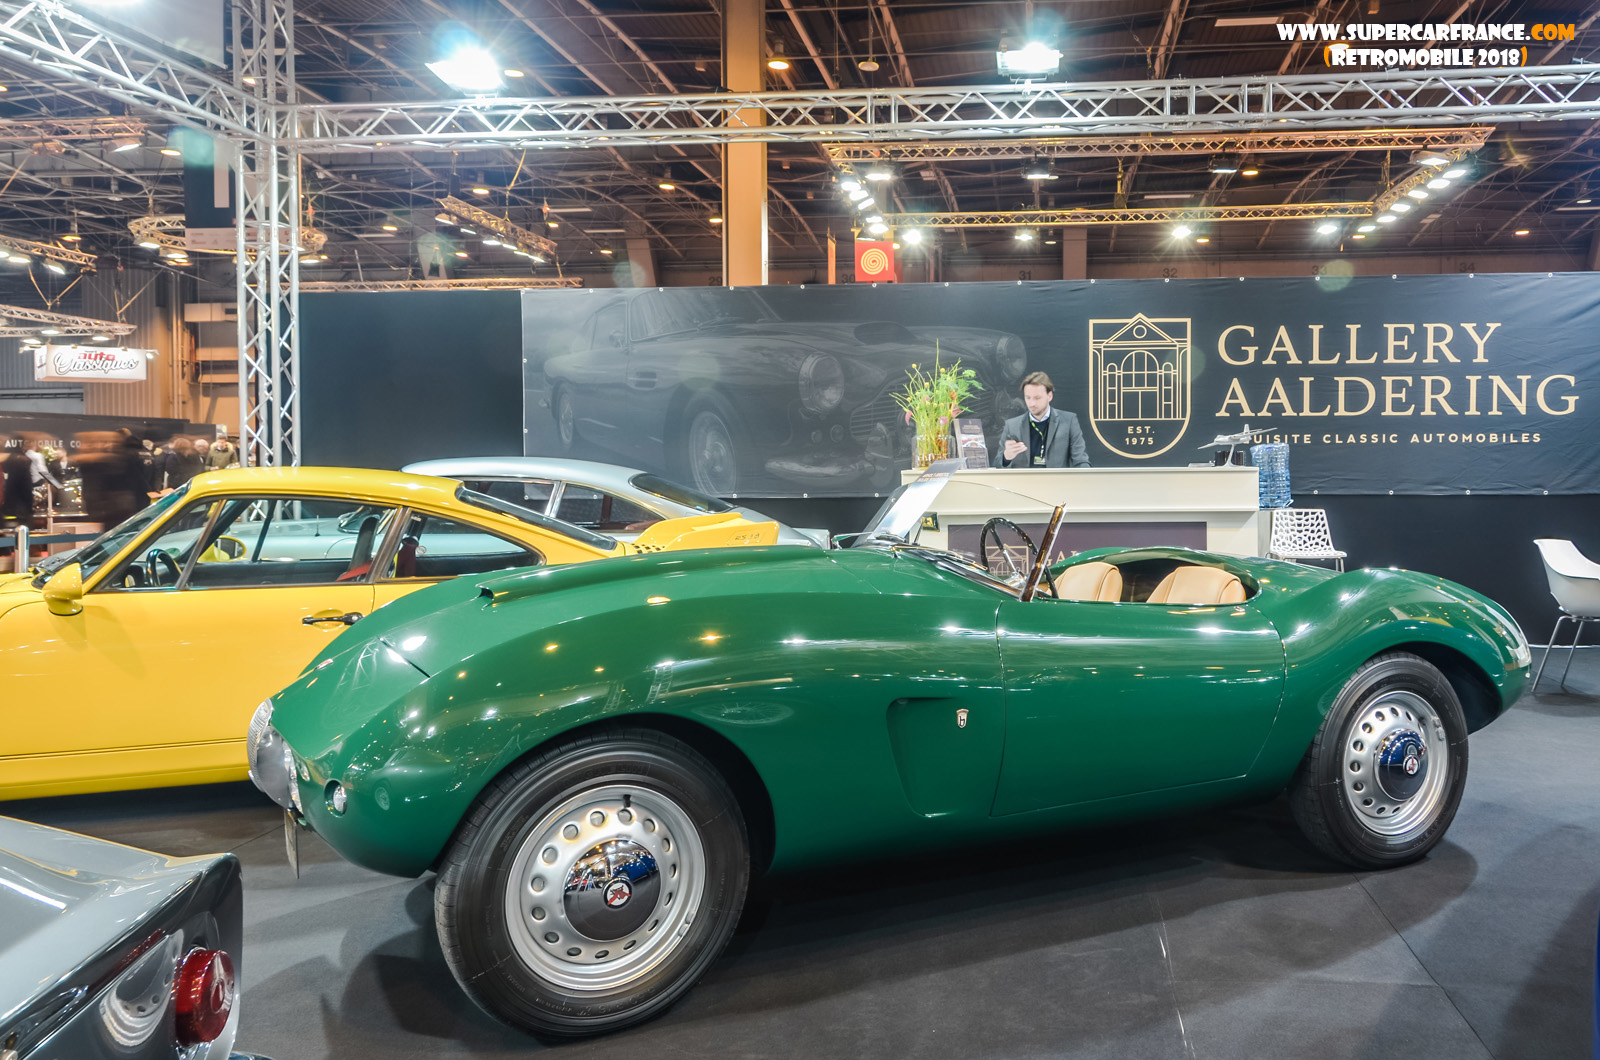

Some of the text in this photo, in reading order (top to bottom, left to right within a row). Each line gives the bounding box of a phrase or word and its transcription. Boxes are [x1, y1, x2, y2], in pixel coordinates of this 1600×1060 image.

[1312, 265, 1328, 276] 33
[1459, 262, 1475, 273] 34
[1019, 271, 1032, 281] 31
[1163, 268, 1178, 278] 32
[841, 274, 855, 284] 30
[1217, 322, 1502, 366] GALLERY
[1215, 374, 1579, 418] AALDERING
[1127, 425, 1156, 434] EST.
[1125, 436, 1155, 446] 1975
[1243, 432, 1542, 444] UISITE CLASSIC AUTOMOBILES
[5, 439, 64, 448] AUTOBILE
